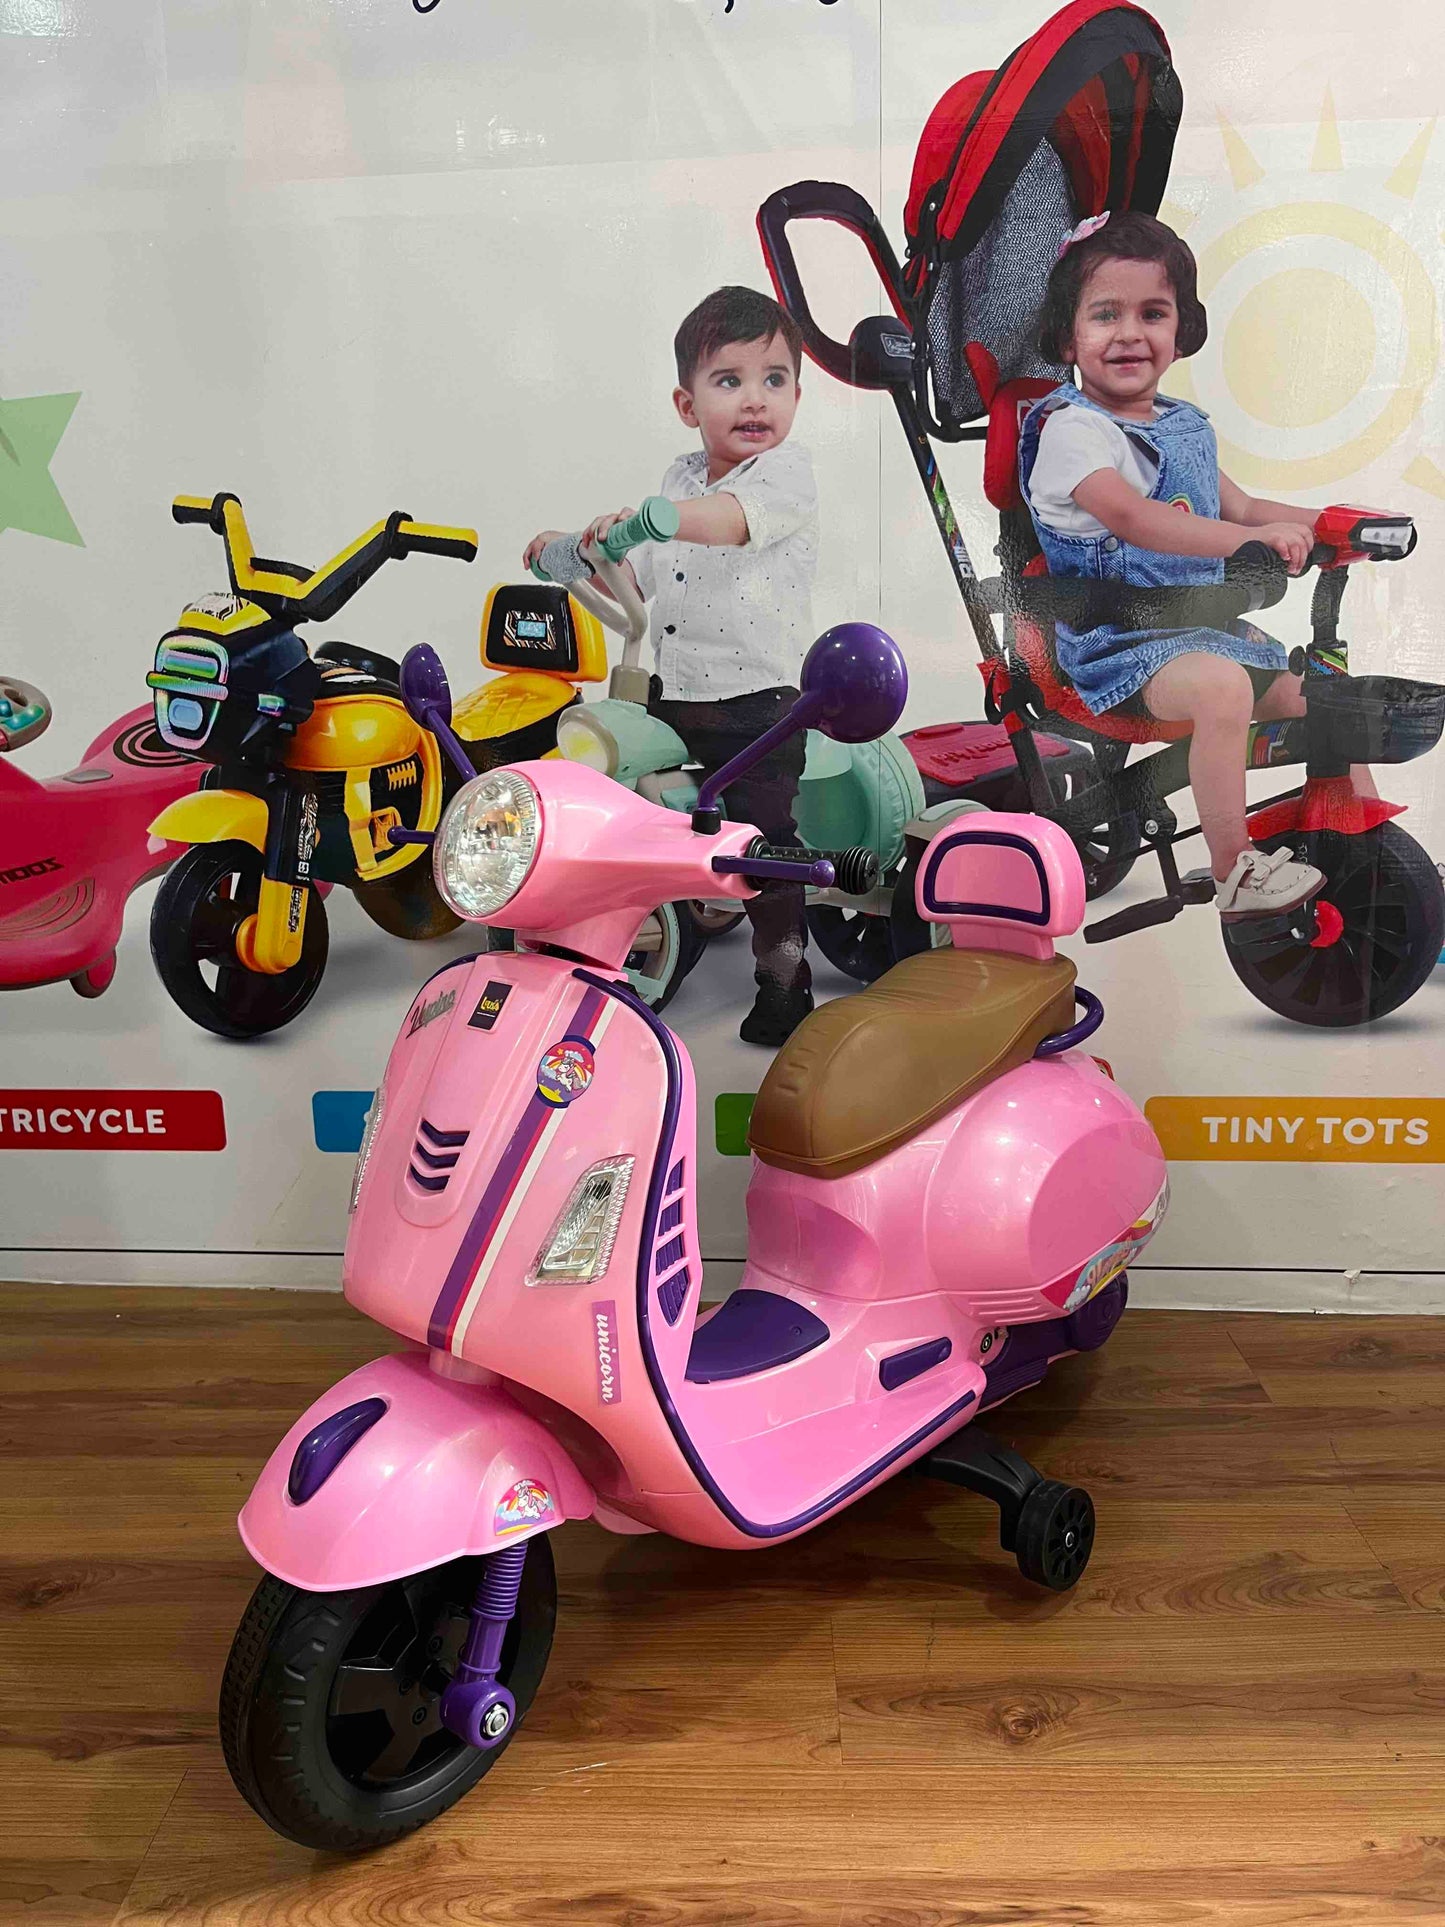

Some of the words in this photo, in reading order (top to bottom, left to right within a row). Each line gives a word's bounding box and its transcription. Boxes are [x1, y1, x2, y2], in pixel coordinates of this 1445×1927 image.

[1202, 1117, 1304, 1143] TINY
[1316, 1117, 1429, 1145] TOTS
[596, 1313, 617, 1403] unicorn
